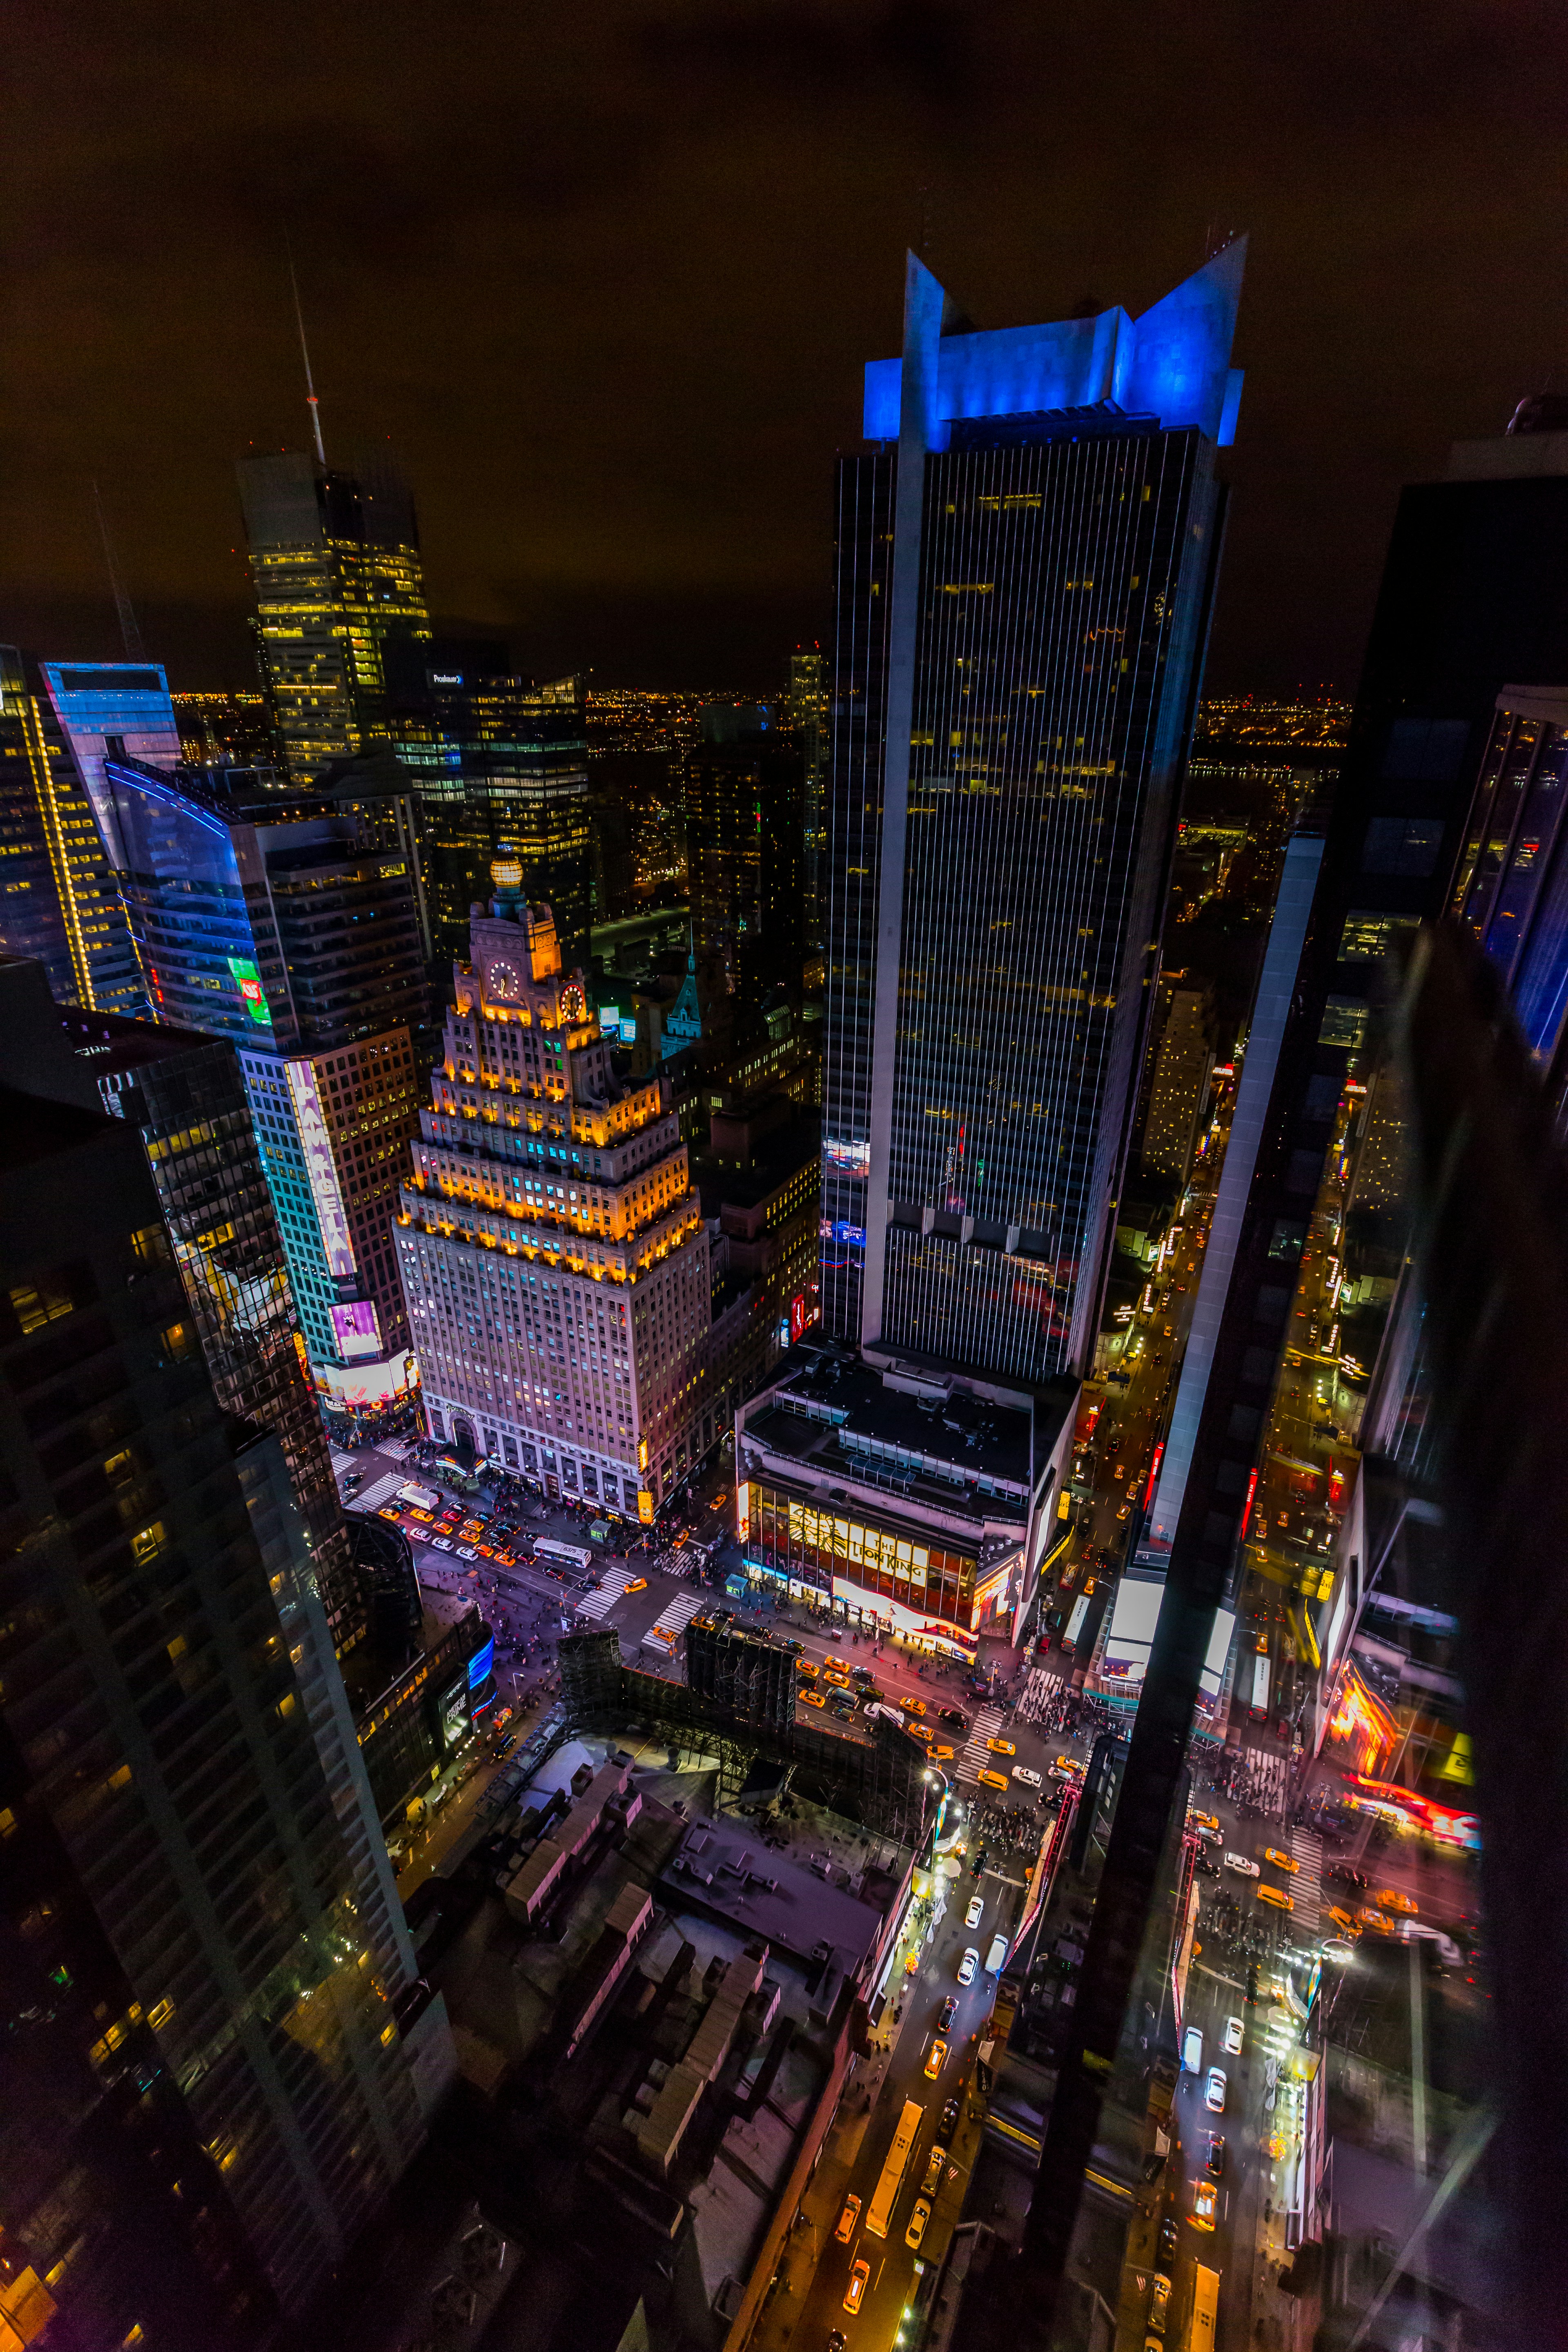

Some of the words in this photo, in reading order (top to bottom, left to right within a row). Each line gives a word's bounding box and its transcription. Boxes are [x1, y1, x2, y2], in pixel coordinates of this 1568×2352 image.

[297, 1087, 326, 1147] PAM
[316, 1178, 347, 1252] GELA
[874, 1539, 894, 1552] THE
[853, 1541, 884, 1563] LION
[886, 1554, 921, 1577] KING
[447, 1693, 466, 1717] AMERICAN
[447, 1699, 466, 1724] CRIME
